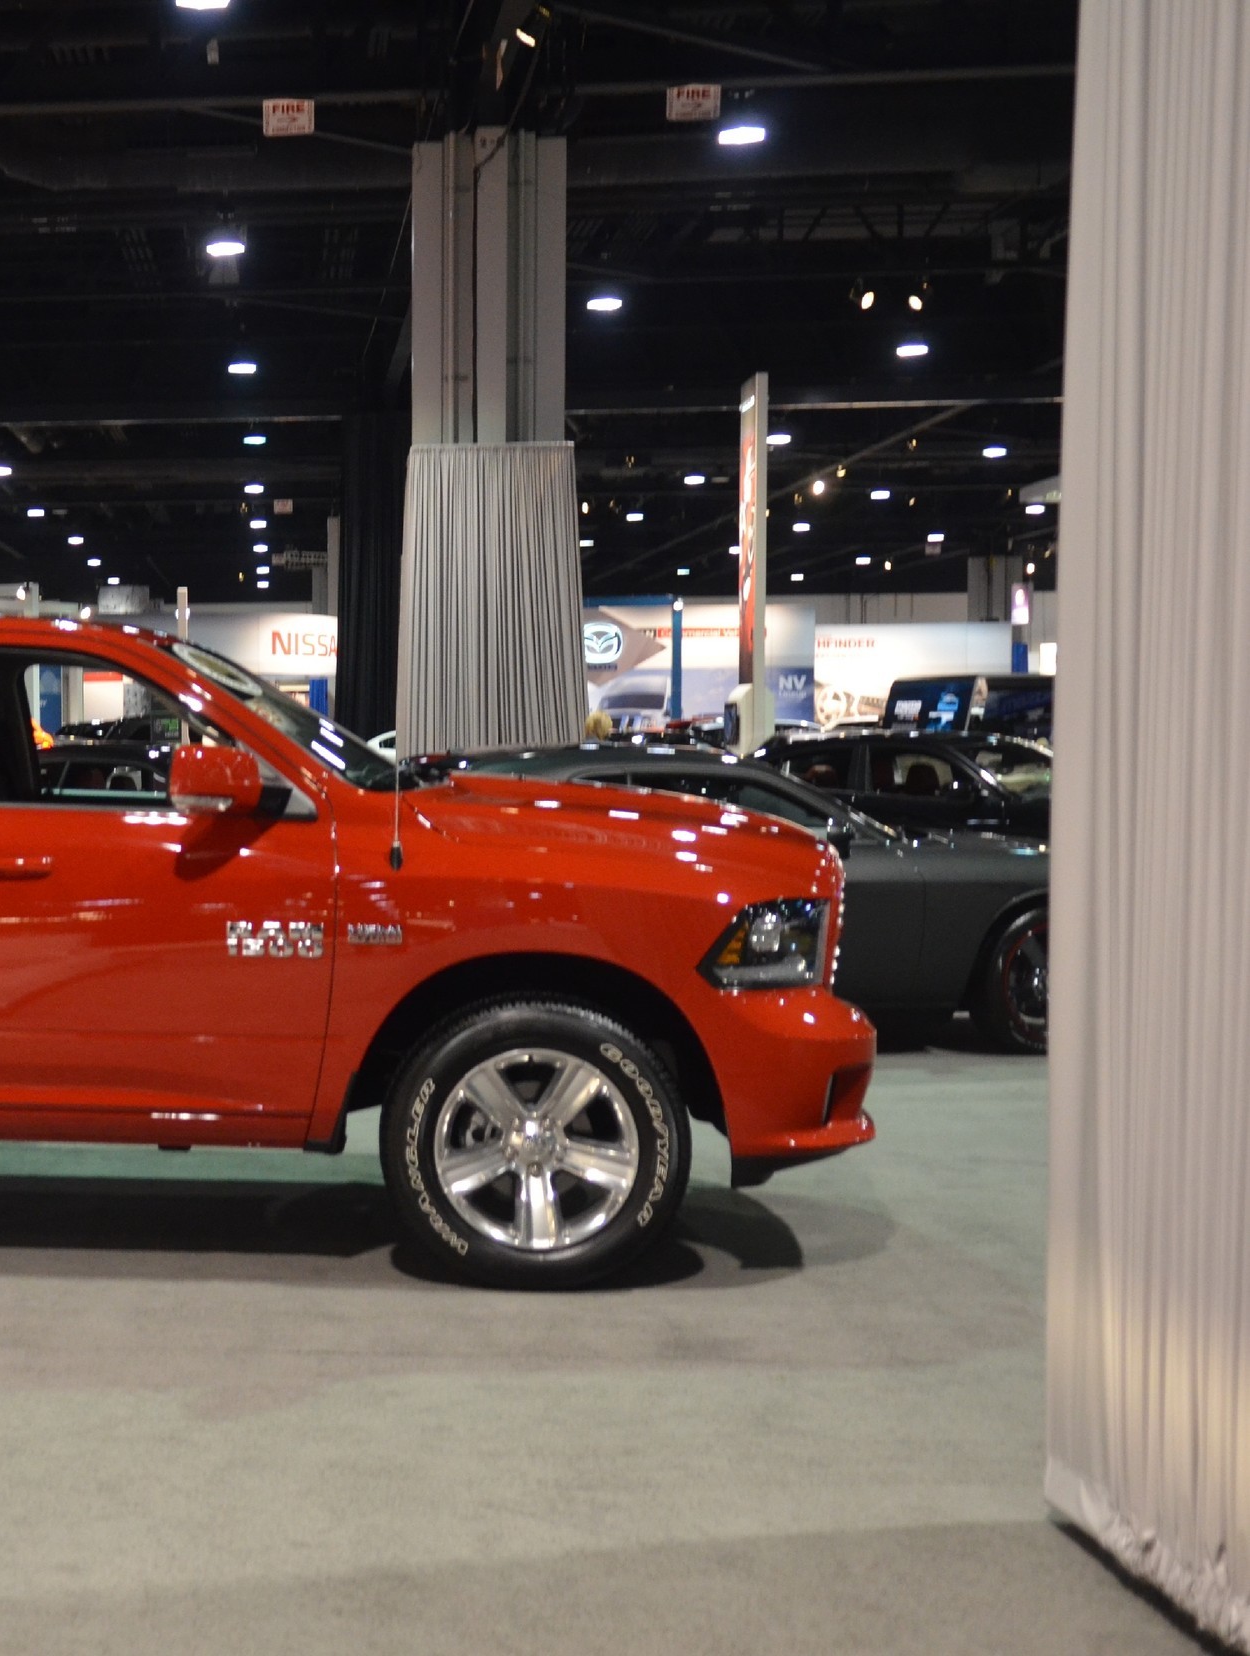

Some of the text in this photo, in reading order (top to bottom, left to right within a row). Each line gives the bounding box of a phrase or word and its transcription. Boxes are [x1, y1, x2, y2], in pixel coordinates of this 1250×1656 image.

[676, 88, 711, 100] FIRE
[272, 102, 305, 114] FIRE
[778, 674, 807, 690] NV
[599, 1042, 670, 1228] GOODYEAR
[405, 1077, 469, 1256] WRANGLER
